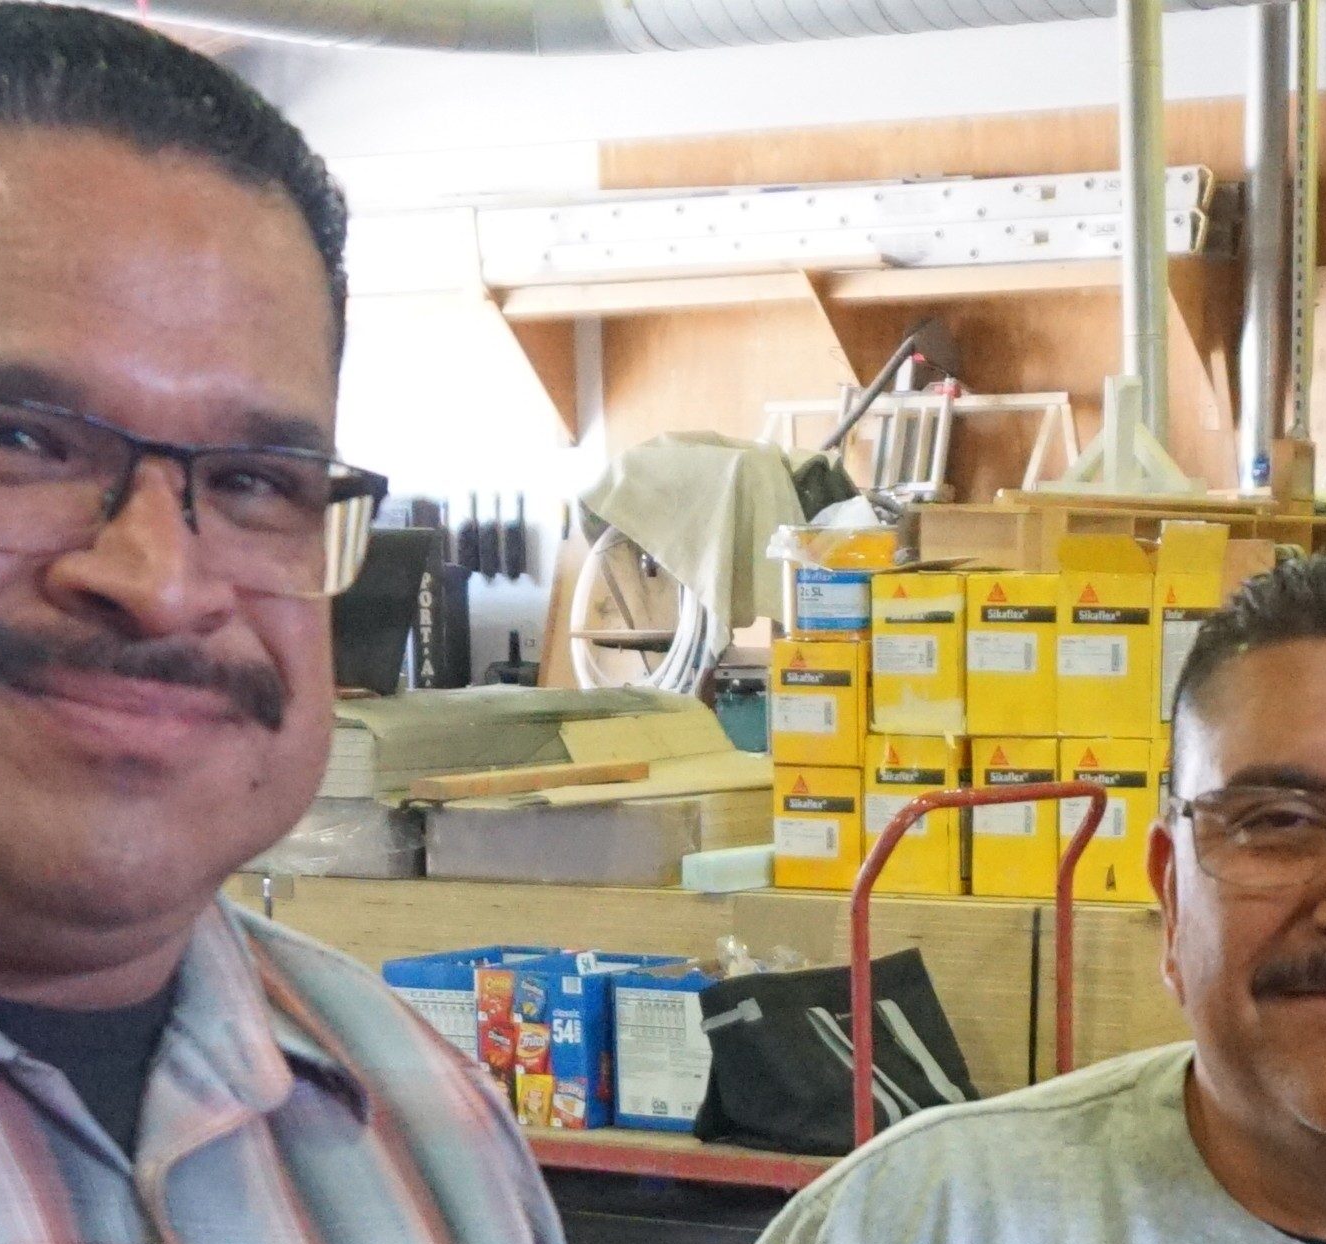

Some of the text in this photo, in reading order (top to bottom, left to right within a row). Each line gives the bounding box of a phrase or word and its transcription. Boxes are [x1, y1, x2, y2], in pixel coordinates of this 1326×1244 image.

[812, 587, 823, 596] SL
[988, 609, 1024, 619] Sikaflex
[1079, 611, 1115, 620] Sikaflex
[787, 673, 819, 682] Sikaflex
[990, 773, 1024, 781] Sikaflex
[790, 799, 823, 808] Sikaflex
[553, 1009, 580, 1017] classic
[553, 1019, 573, 1043] 54
